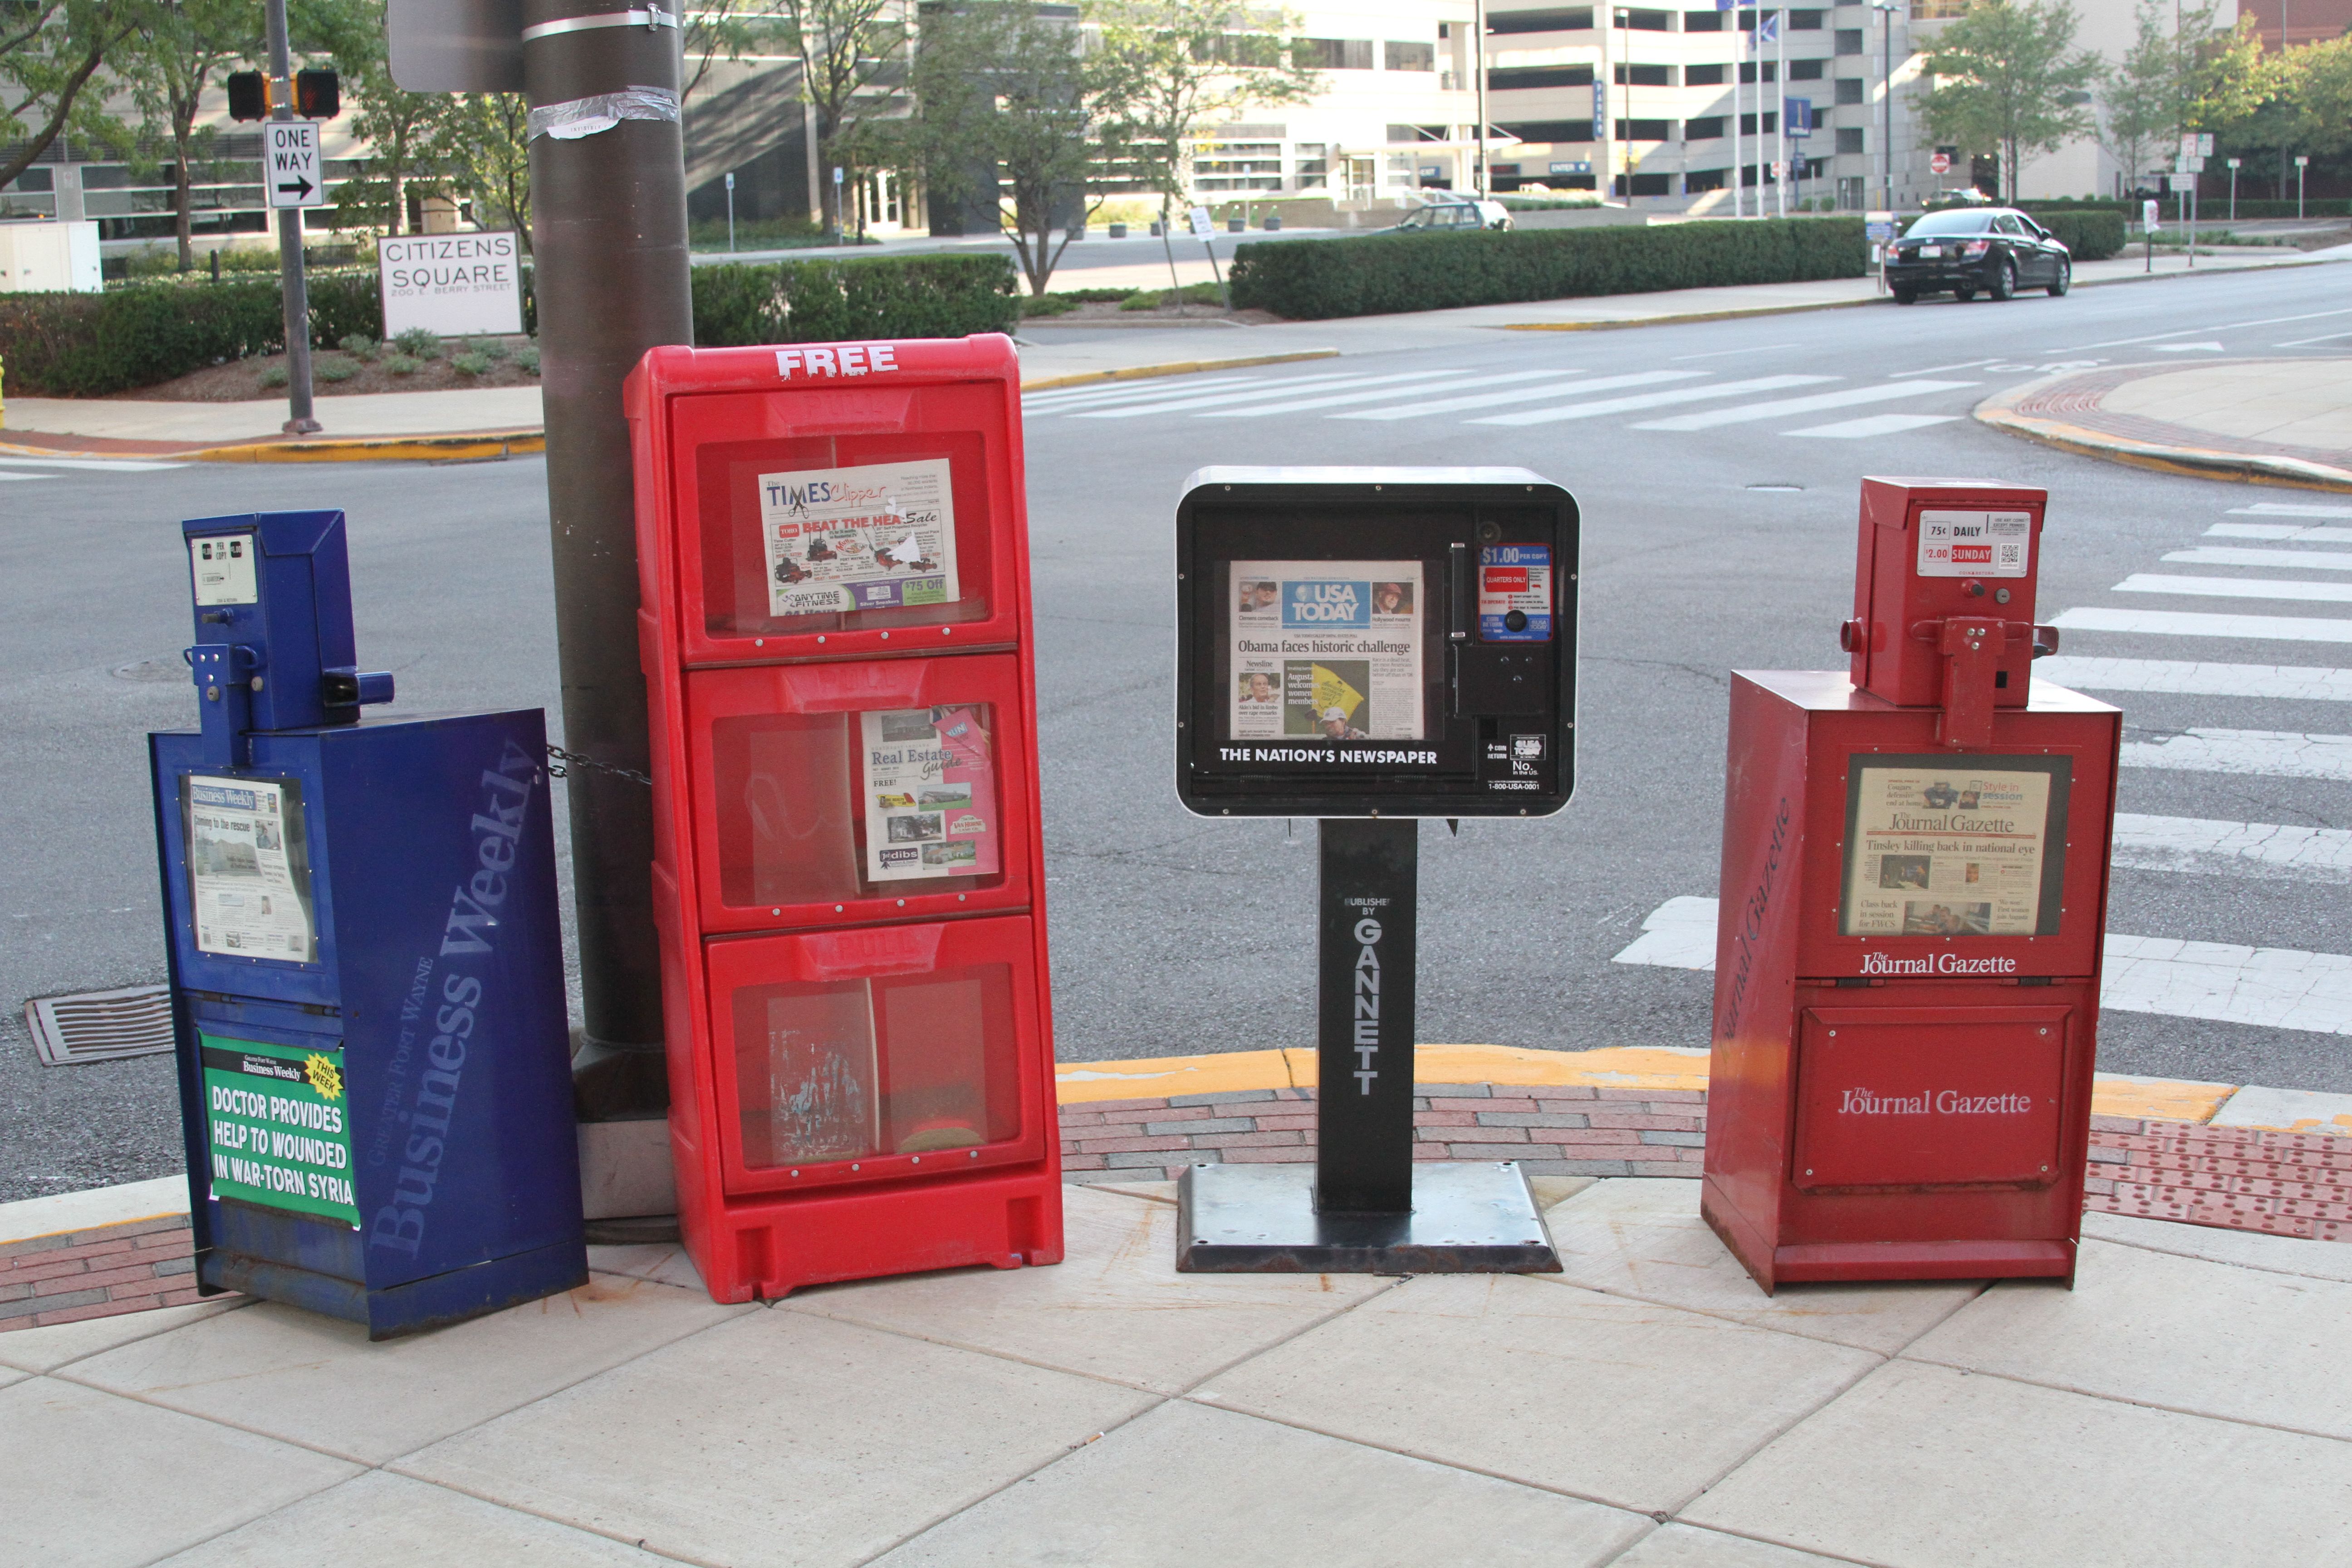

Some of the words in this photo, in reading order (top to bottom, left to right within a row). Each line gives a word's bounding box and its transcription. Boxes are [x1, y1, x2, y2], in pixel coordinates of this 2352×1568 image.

[275, 130, 310, 148] ONE
[275, 152, 312, 171] WAY
[386, 238, 511, 261] CITIZENS
[393, 264, 509, 287] SQUARE
[434, 285, 468, 294] BERRY
[473, 283, 511, 292] STREET
[775, 346, 899, 380] FREE
[766, 482, 831, 506] TIMES
[830, 482, 887, 508] Clipper
[803, 519, 838, 533] BEAT
[842, 517, 869, 528] THE
[873, 514, 904, 526] HEA
[903, 512, 937, 524] Sale
[1931, 526, 1945, 535] 75¢
[1954, 527, 1980, 536] DAILY
[216, 552, 226, 560] COPY
[1483, 546, 1519, 564] $1.00
[1926, 549, 1947, 558] $2.00
[1952, 549, 1991, 560] SUNDAY
[906, 580, 923, 591] $75
[927, 578, 943, 589] Off
[1315, 584, 1357, 603] USA
[795, 591, 840, 602] ANYTIME
[1293, 602, 1359, 621] TODAY
[1239, 640, 1279, 653] Obama
[1282, 640, 1309, 653] faces
[1312, 640, 1354, 653] historic
[1357, 640, 1410, 655] challenge
[872, 751, 902, 765] Real
[907, 749, 951, 763] Estate
[1220, 748, 1250, 761] THE
[1255, 749, 1335, 762] NATION'S
[1340, 750, 1437, 764] NEWSPAPER
[1513, 761, 1533, 771] No.
[873, 779, 897, 787] FREE!
[1983, 782, 2007, 793] Style
[2009, 783, 2019, 791] in
[192, 786, 225, 804] Business
[225, 789, 254, 808] Weekly
[1982, 792, 2023, 801] session
[213, 817, 219, 828] to
[220, 818, 229, 829] the
[230, 822, 250, 832] rescue
[1889, 813, 1947, 831] Journal
[1951, 814, 2014, 833] Gazette
[891, 850, 917, 859] dibs
[1866, 840, 1901, 853] Tinsley
[1904, 840, 1935, 853] killing
[1937, 841, 1959, 851] back
[1963, 842, 1972, 852] in
[1975, 843, 2015, 853] national
[2018, 847, 2035, 856] eye
[1746, 797, 1790, 941] Gazette
[1362, 907, 1375, 916] BY
[1861, 900, 1879, 908] Class
[1881, 900, 1897, 908] back
[1860, 954, 1934, 974] Journal
[1938, 954, 2016, 974] Gazette
[1872, 952, 1889, 960] The
[400, 956, 433, 1022] WAYNE
[368, 974, 482, 1261] Business
[440, 737, 544, 956] Weekly
[1353, 918, 1382, 1095] GANNETT
[388, 1028, 416, 1087] FORT
[243, 1060, 274, 1077] Business
[274, 1066, 301, 1082] Weekly
[317, 1059, 335, 1078] THIS
[313, 1072, 335, 1093] WEEK
[1838, 1090, 1931, 1114] Journal
[1936, 1090, 2031, 1114] Gazette
[1854, 1088, 1874, 1097] The
[213, 1085, 267, 1119] DOCTOR
[270, 1096, 342, 1134] PROVIDES
[214, 1120, 247, 1149] HELP
[251, 1127, 269, 1154] TO
[273, 1131, 347, 1170] WOUNDED
[214, 1153, 229, 1179] IN
[231, 1157, 306, 1196] WAR-TORN
[308, 1172, 354, 1206] SYRIA
